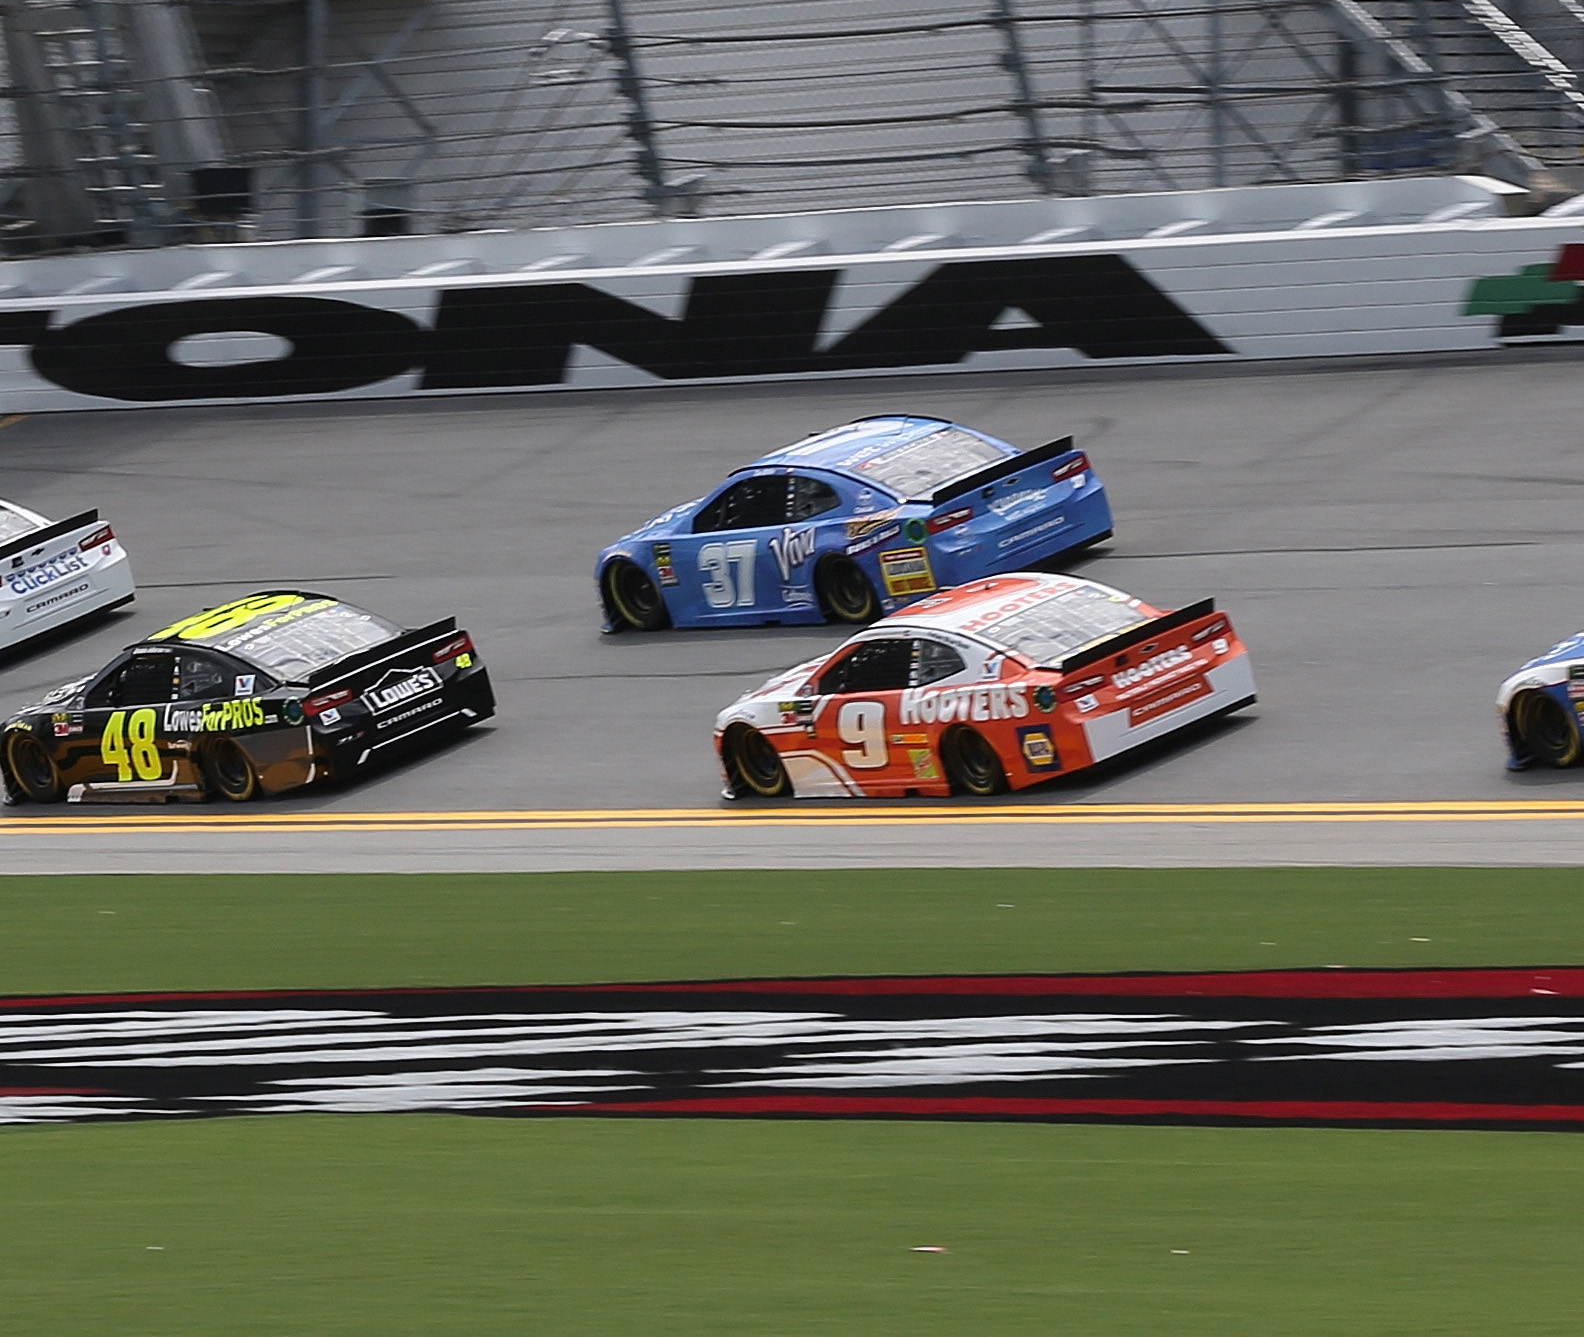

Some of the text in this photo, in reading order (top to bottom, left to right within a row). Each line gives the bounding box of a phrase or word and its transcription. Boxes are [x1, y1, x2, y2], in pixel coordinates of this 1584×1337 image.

[10, 556, 89, 595] ClickList
[697, 539, 758, 608] 37
[958, 581, 1079, 632] HOOTERS
[370, 673, 435, 709] LOWE'S
[900, 682, 1030, 725] HOOTERS
[100, 708, 163, 782] 48
[838, 701, 889, 769] 9
